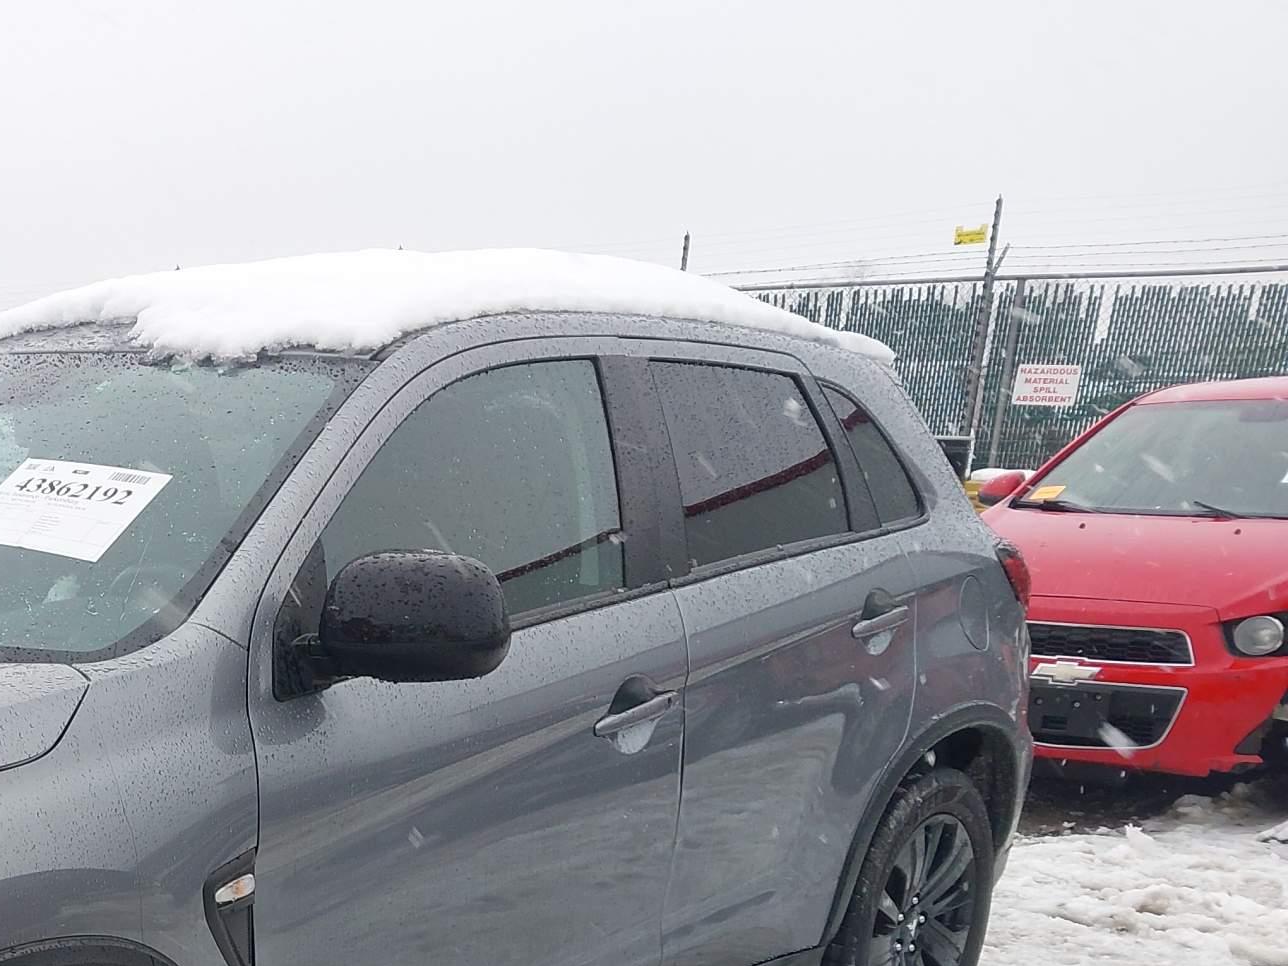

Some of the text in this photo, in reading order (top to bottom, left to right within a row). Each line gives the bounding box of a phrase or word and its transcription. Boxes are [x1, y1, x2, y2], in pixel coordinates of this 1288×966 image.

[1020, 367, 1079, 375] HAZARDOUS
[1024, 377, 1070, 385] MATERIAL
[1033, 386, 1058, 394] SPILL
[1016, 395, 1072, 403] ABSORBENT
[15, 477, 133, 505] 43862192
